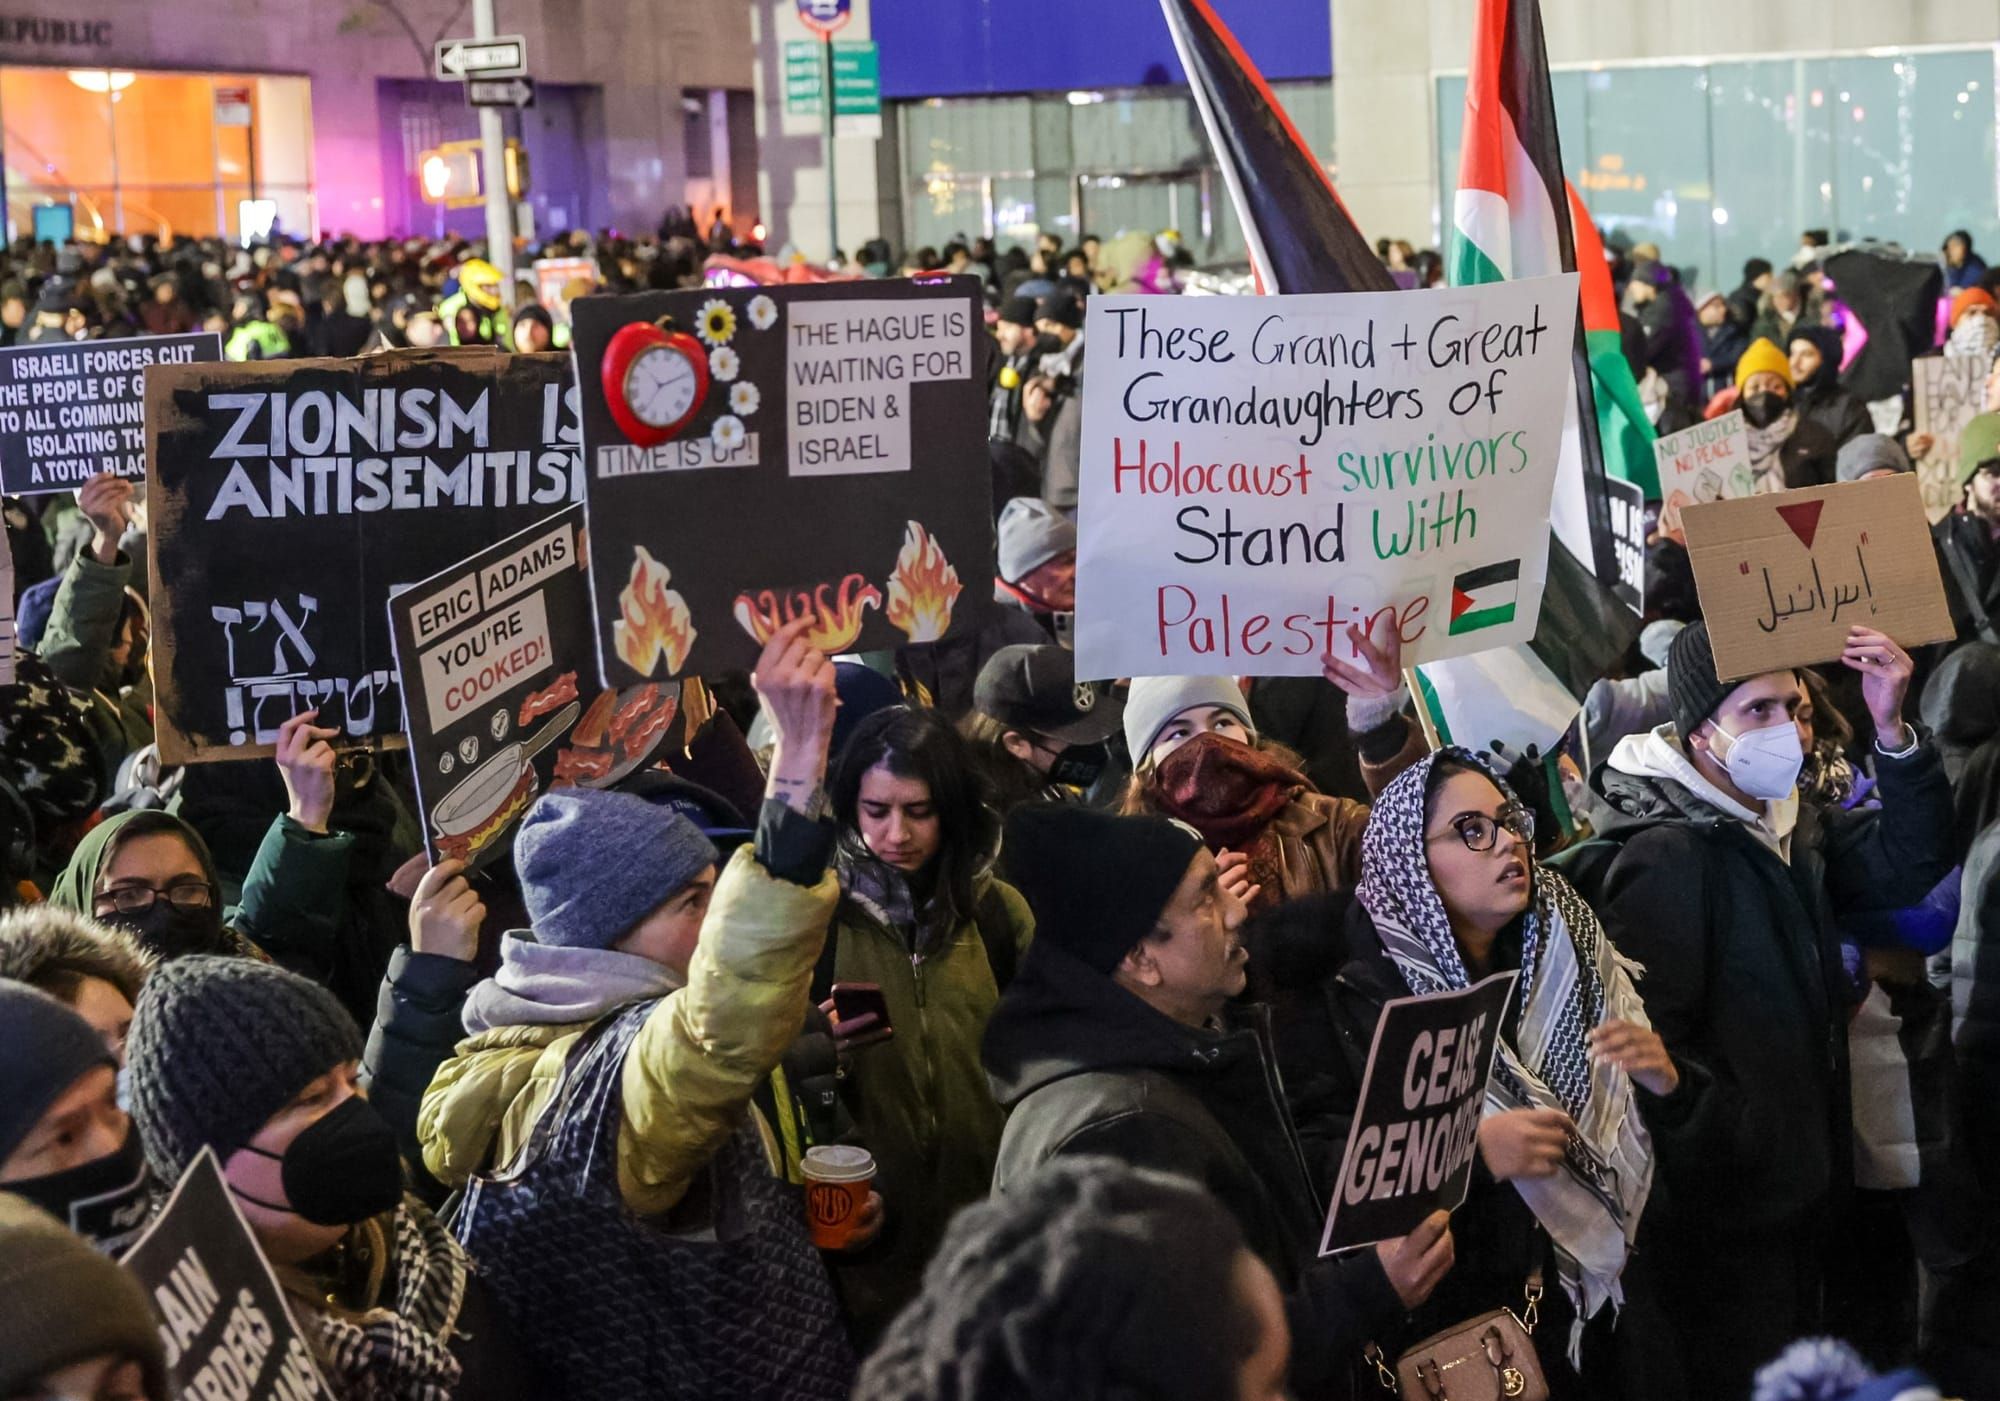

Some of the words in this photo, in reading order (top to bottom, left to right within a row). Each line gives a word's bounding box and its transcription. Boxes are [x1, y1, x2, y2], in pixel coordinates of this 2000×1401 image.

[794, 323, 838, 347] THE
[846, 313, 935, 344] HAGUE
[943, 312, 965, 337] IS
[1104, 308, 1235, 363] These
[1252, 314, 1375, 369] Grand
[1391, 323, 1418, 361] +
[1427, 304, 1548, 369] Great
[12, 353, 79, 379] ISRAELI
[84, 348, 154, 374] FORCES
[158, 345, 195, 364] CUT
[793, 355, 904, 387] WAITING
[912, 350, 963, 379] FOR
[0, 384, 29, 407] THE
[32, 378, 99, 405] PEOPLE
[103, 375, 127, 398] OF
[797, 396, 875, 426] BIDEN
[883, 394, 901, 419] &
[1123, 371, 1424, 447] Grandaughters
[0, 411, 20, 434] TO
[25, 408, 56, 432] ALL
[26, 430, 117, 457] ISOLATING
[208, 386, 490, 459] ZIONISM
[1659, 436, 1680, 461] NO
[1685, 414, 1741, 450] JUSTICE
[31, 462, 44, 484] A
[45, 457, 98, 482] TOTAL
[601, 445, 668, 475] TIME
[677, 440, 703, 466] IS
[798, 434, 889, 466] ISRAEL
[1113, 437, 1313, 497] Holocaust
[1337, 430, 1529, 492] survivors
[1675, 453, 1694, 475] NO
[204, 450, 587, 520] ANTISEMITIS
[1173, 502, 1345, 567] Stand
[1372, 489, 1477, 560] With
[418, 589, 473, 637] ERIC
[488, 537, 567, 599] ADAMS
[437, 611, 523, 675] YOU'RE
[1157, 584, 1430, 658] Palestine
[444, 636, 546, 712] COOKED!
[1402, 1011, 1488, 1111] CEASE
[1343, 1087, 1486, 1206] GENOCIDE
